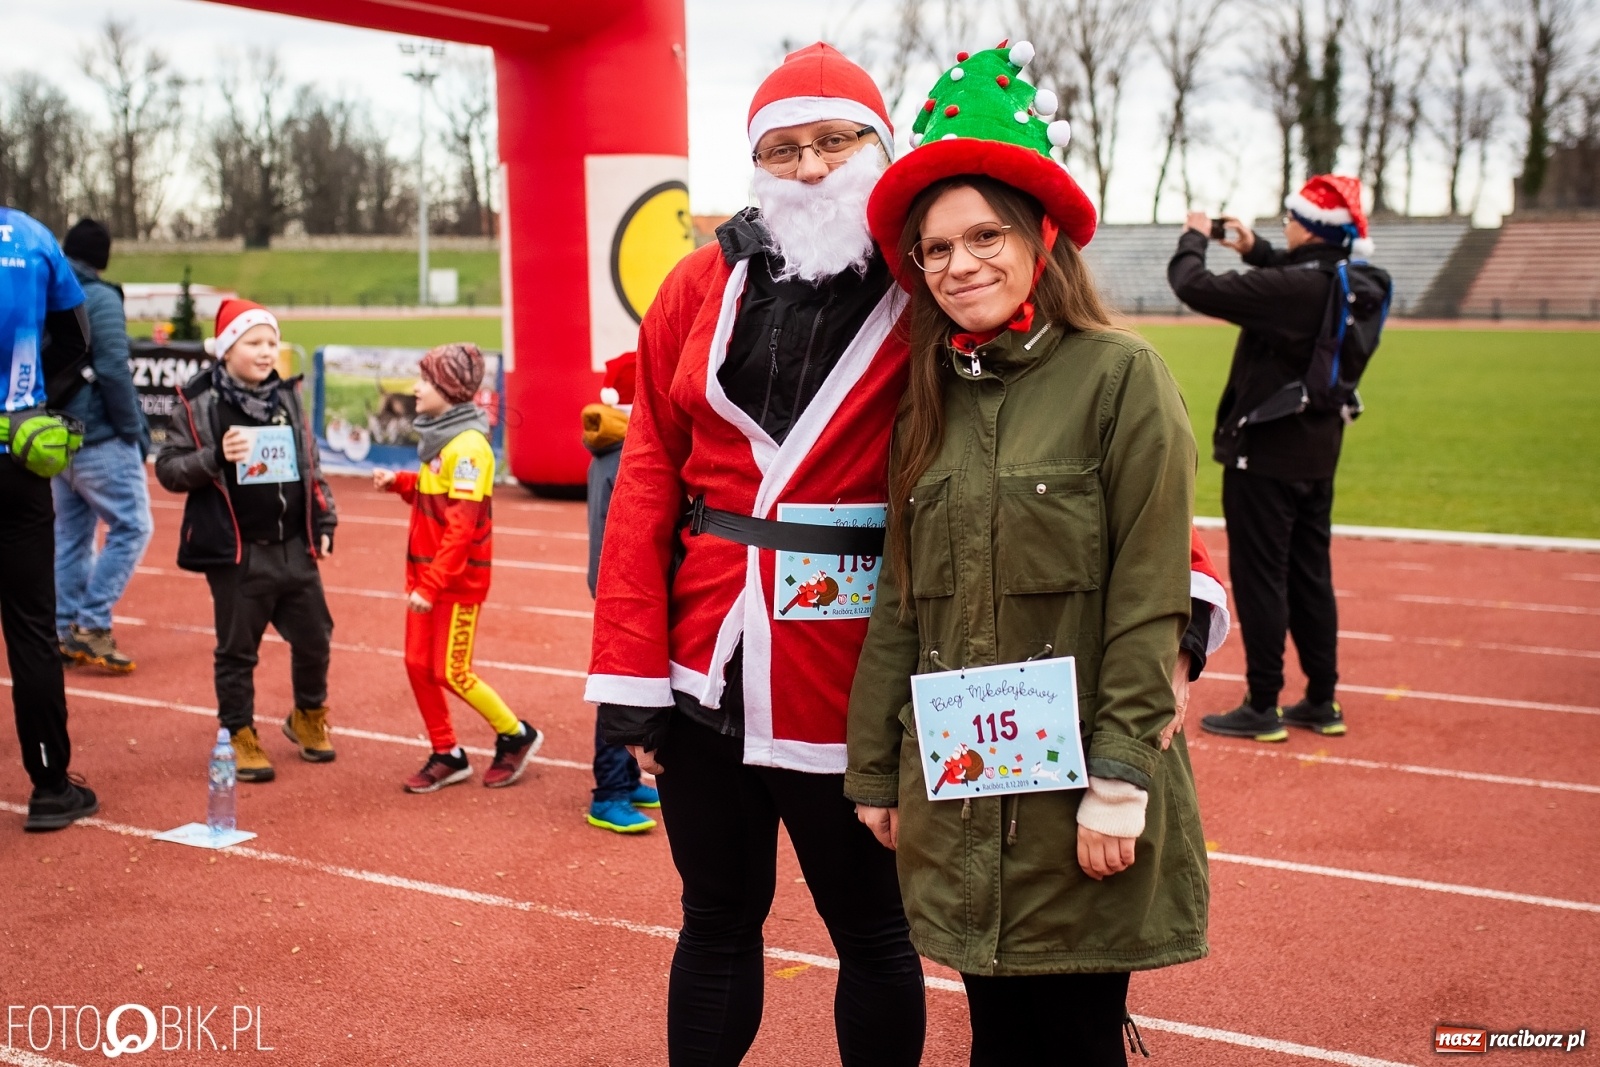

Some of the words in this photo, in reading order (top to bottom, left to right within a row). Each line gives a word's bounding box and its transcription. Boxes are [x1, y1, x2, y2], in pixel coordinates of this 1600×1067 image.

[0, 256, 26, 268] EAM
[261, 446, 286, 460] 025
[854, 606, 873, 615] 8.12.201
[929, 694, 965, 712] Bieg
[972, 709, 1019, 744] 115
